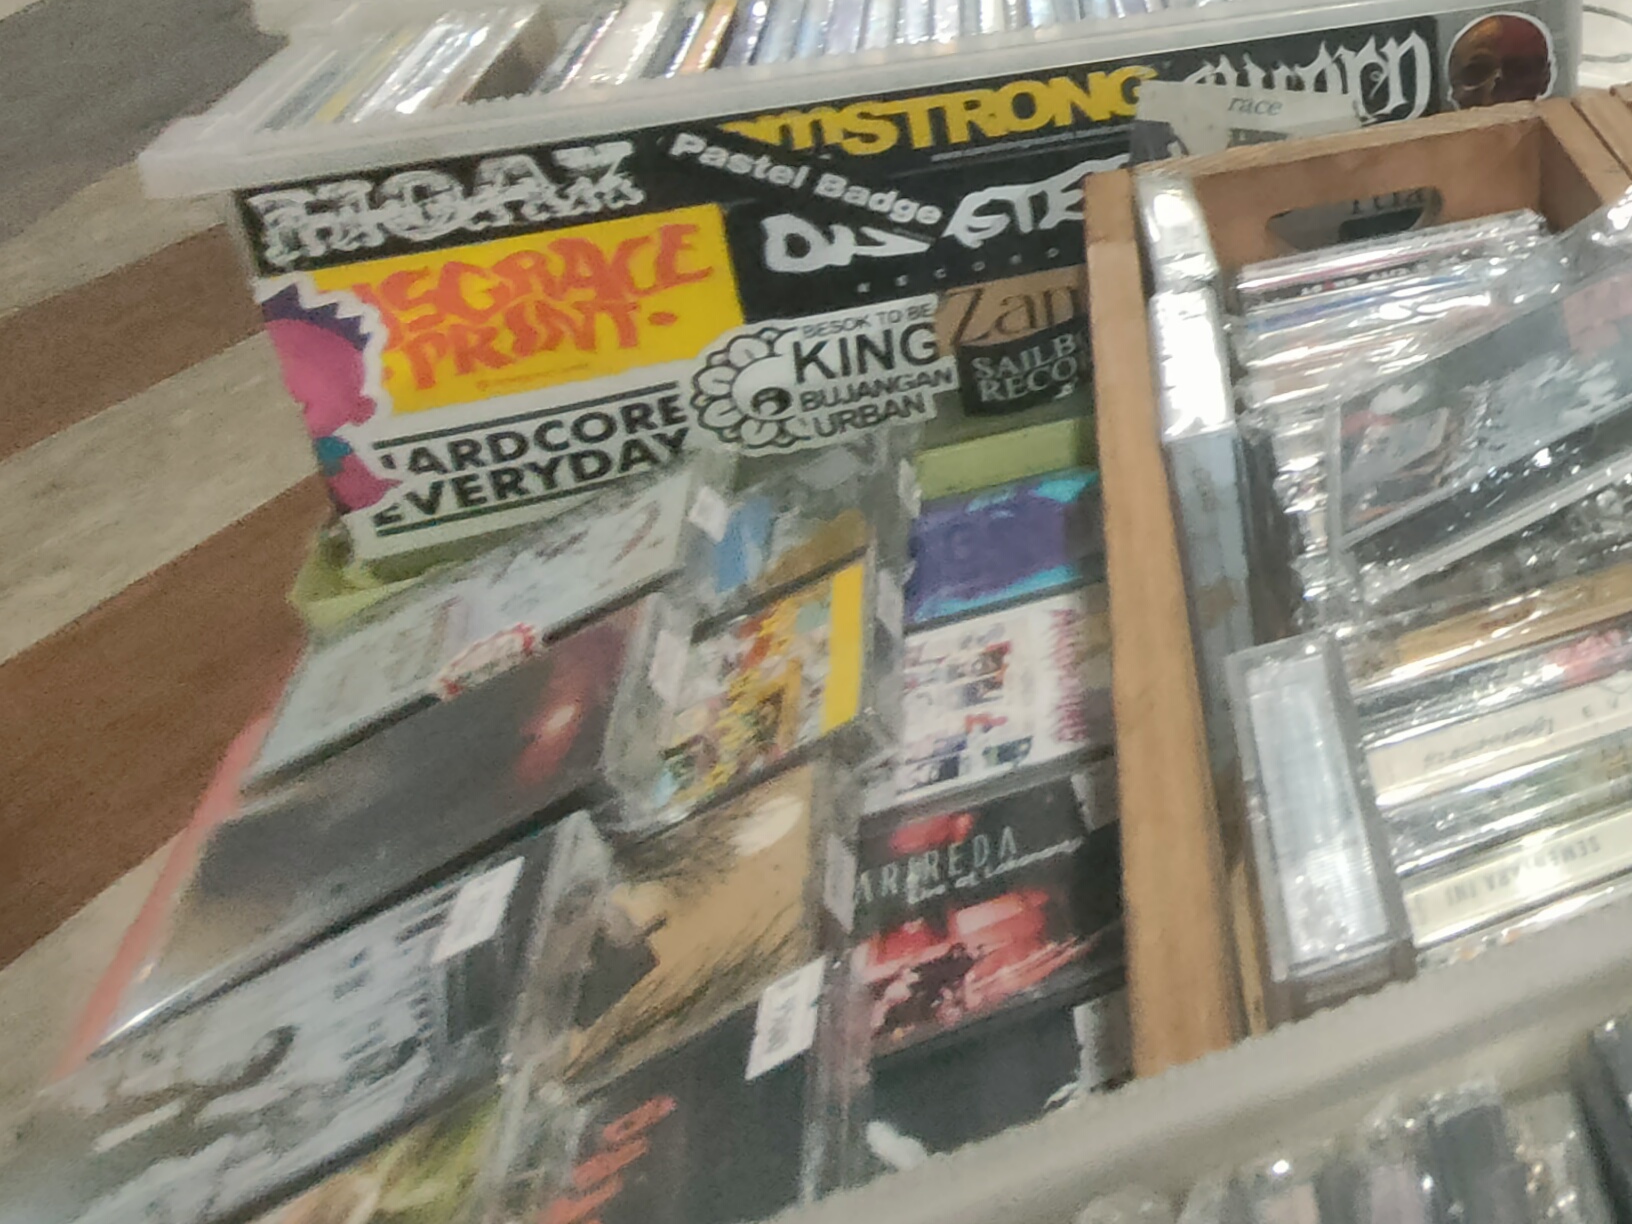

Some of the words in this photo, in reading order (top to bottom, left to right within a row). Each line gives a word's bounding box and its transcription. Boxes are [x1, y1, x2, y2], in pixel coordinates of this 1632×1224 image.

[669, 131, 810, 190] Pastel
[814, 171, 944, 226] Badge
[803, 313, 871, 340] BESOK
[875, 309, 900, 325] TO
[908, 303, 934, 319] BE
[792, 322, 939, 384] KING
[800, 363, 954, 414] BUJANGAN
[813, 391, 927, 439] URBAN
[380, 392, 690, 476] ARDCORE
